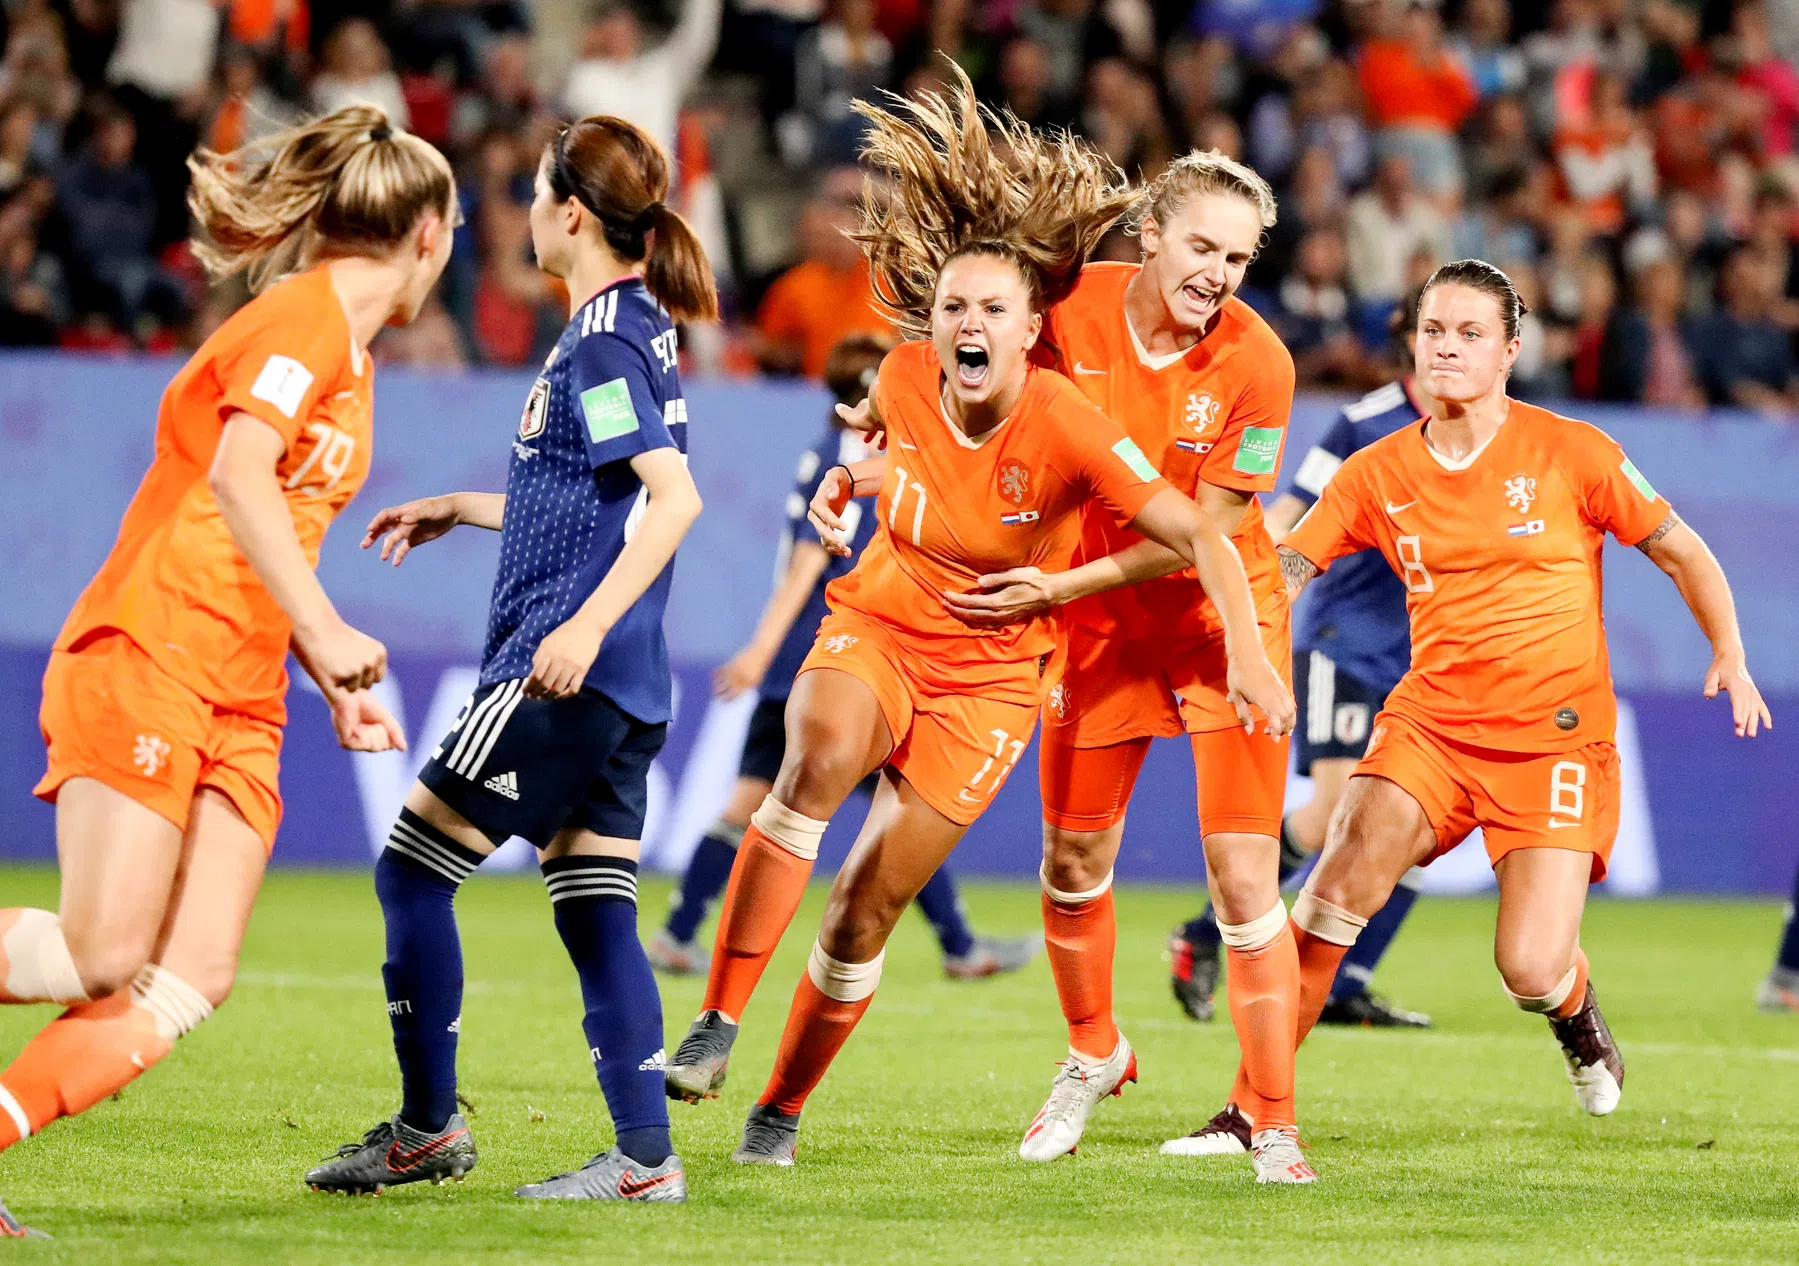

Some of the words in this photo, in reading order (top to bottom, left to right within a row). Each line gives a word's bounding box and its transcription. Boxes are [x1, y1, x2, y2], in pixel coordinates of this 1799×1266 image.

[889, 466, 927, 546] 11
[1396, 535, 1433, 593] 8
[484, 779, 520, 801] adidas
[970, 728, 1025, 795] 11
[1550, 761, 1585, 818] 8
